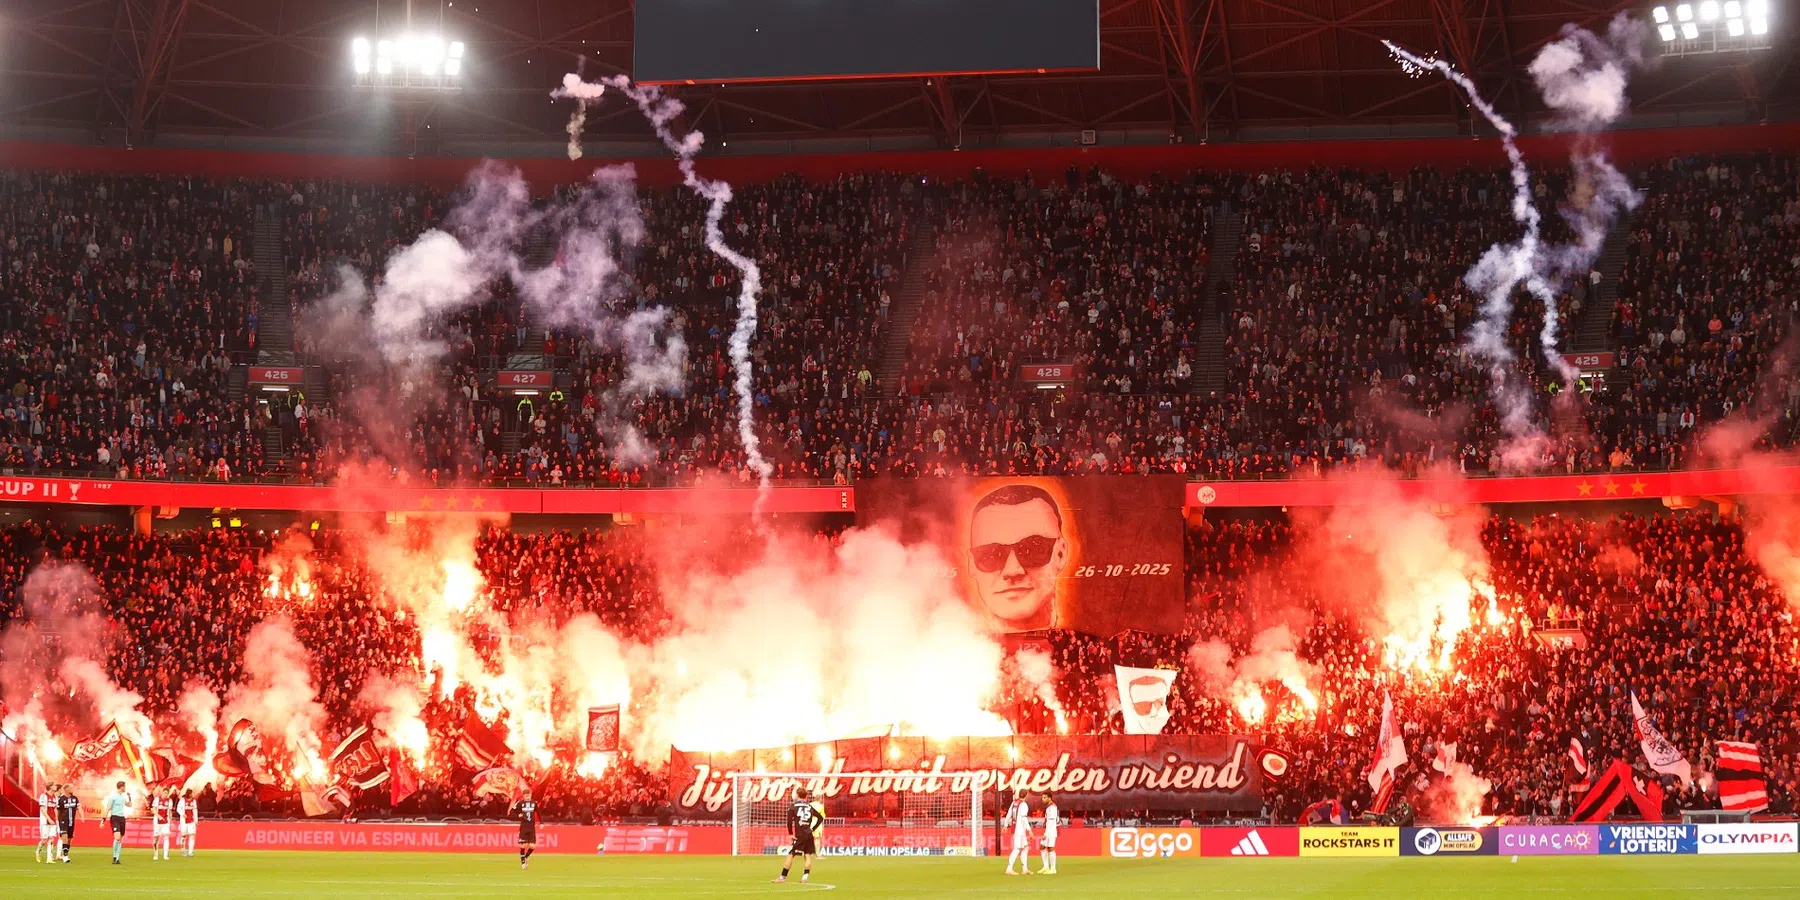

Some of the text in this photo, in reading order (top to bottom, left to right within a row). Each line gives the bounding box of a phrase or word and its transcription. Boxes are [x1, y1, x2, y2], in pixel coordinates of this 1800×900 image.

[1575, 356, 1599, 365] 429
[264, 371, 289, 380] 426
[513, 374, 536, 383] 427
[1037, 368, 1061, 377] 428
[0, 481, 35, 496] UP
[682, 742, 1246, 812] Jij wordt nooit vergeten vriend
[796, 805, 812, 820] 45
[1610, 826, 1687, 839] VRIENDEN
[1701, 833, 1794, 844] OLYMPIA
[244, 830, 558, 848] ABONNEER VIA ESPN.NL/ABONNEEN
[603, 828, 688, 852] ESPN
[1303, 838, 1395, 848] ROCKSTARS IT
[820, 847, 930, 857] ALLSAFE MINI OPSLAG
[1620, 839, 1677, 853] LOTERIJ
